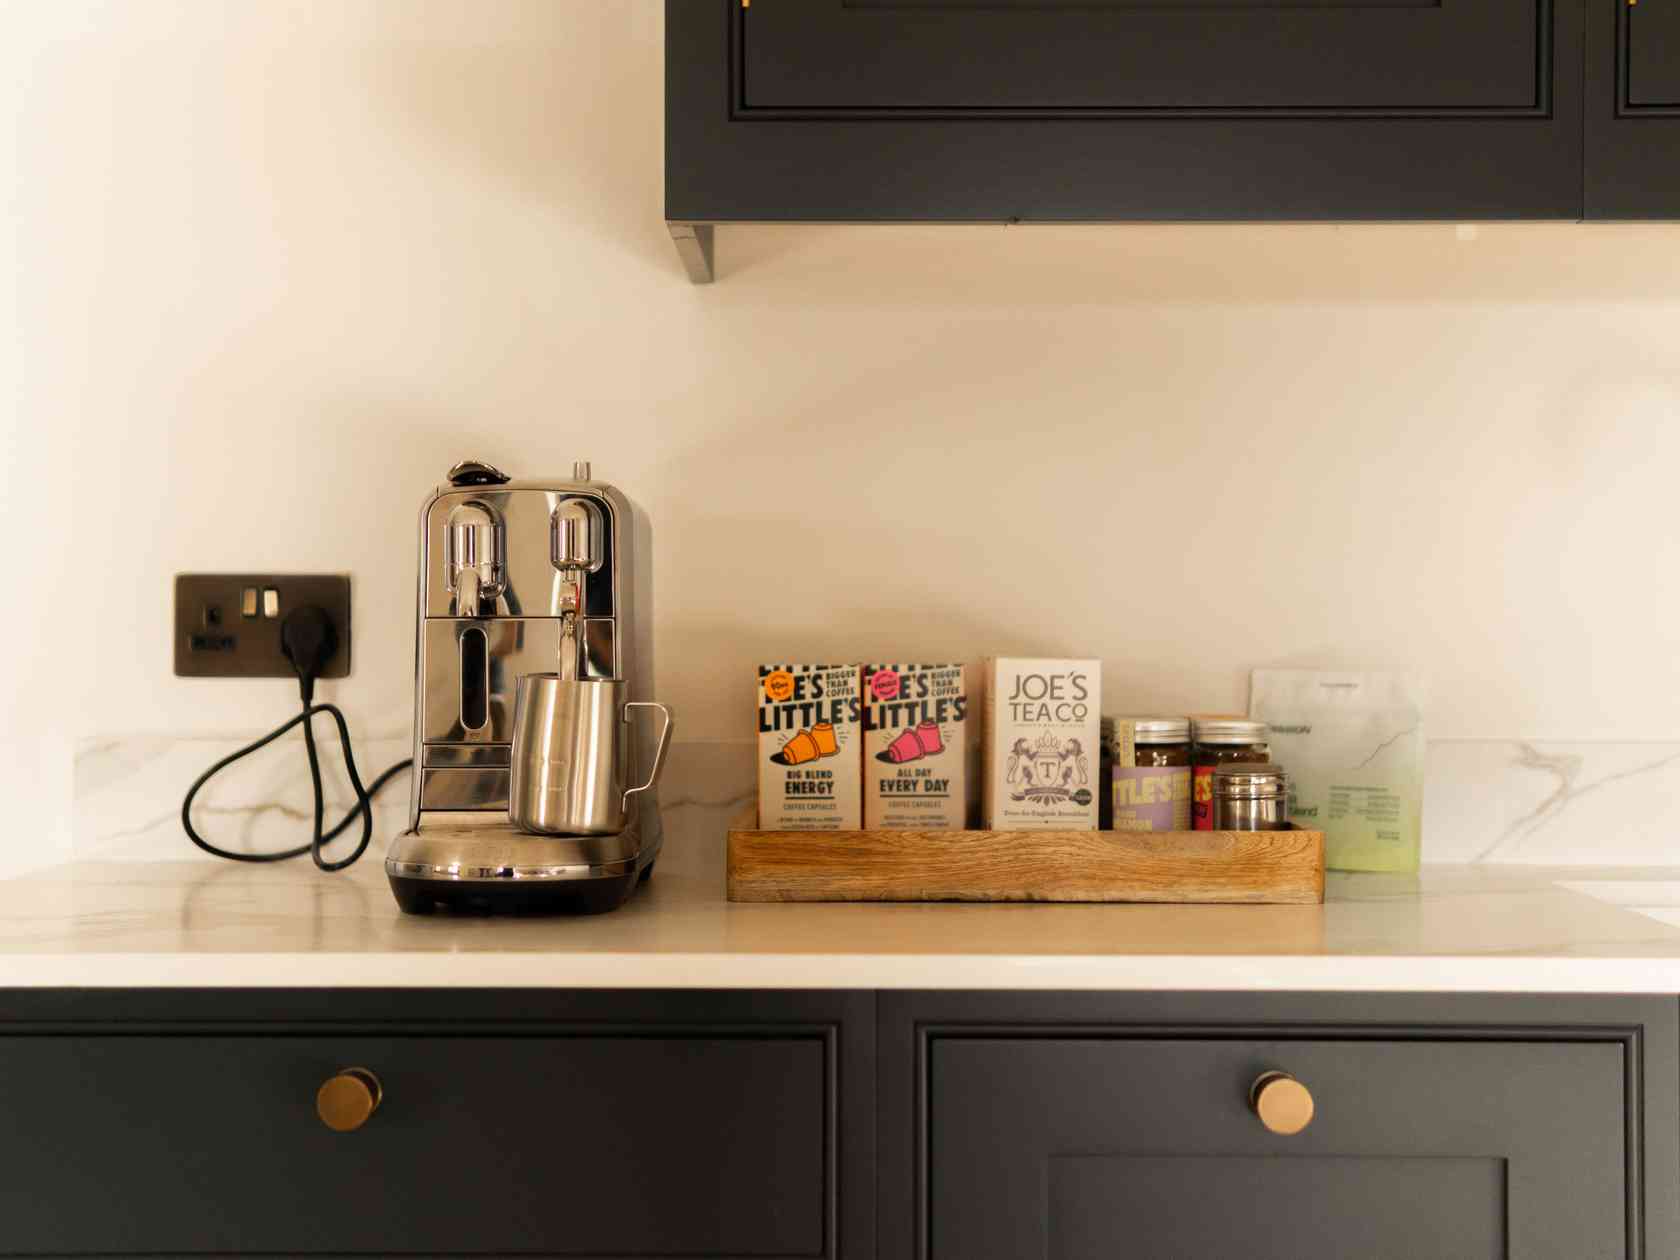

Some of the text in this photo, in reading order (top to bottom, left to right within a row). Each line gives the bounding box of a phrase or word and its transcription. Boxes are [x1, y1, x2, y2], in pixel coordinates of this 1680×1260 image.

[1008, 671, 1088, 701] JOE'S
[759, 697, 861, 733] LITTLE'S
[863, 696, 967, 731] LITTLE'S
[787, 770, 833, 779] BIG BLEND
[897, 768, 932, 777] ALL DAY
[785, 780, 834, 794] ENERGY
[880, 779, 950, 792] EVERY DAY
